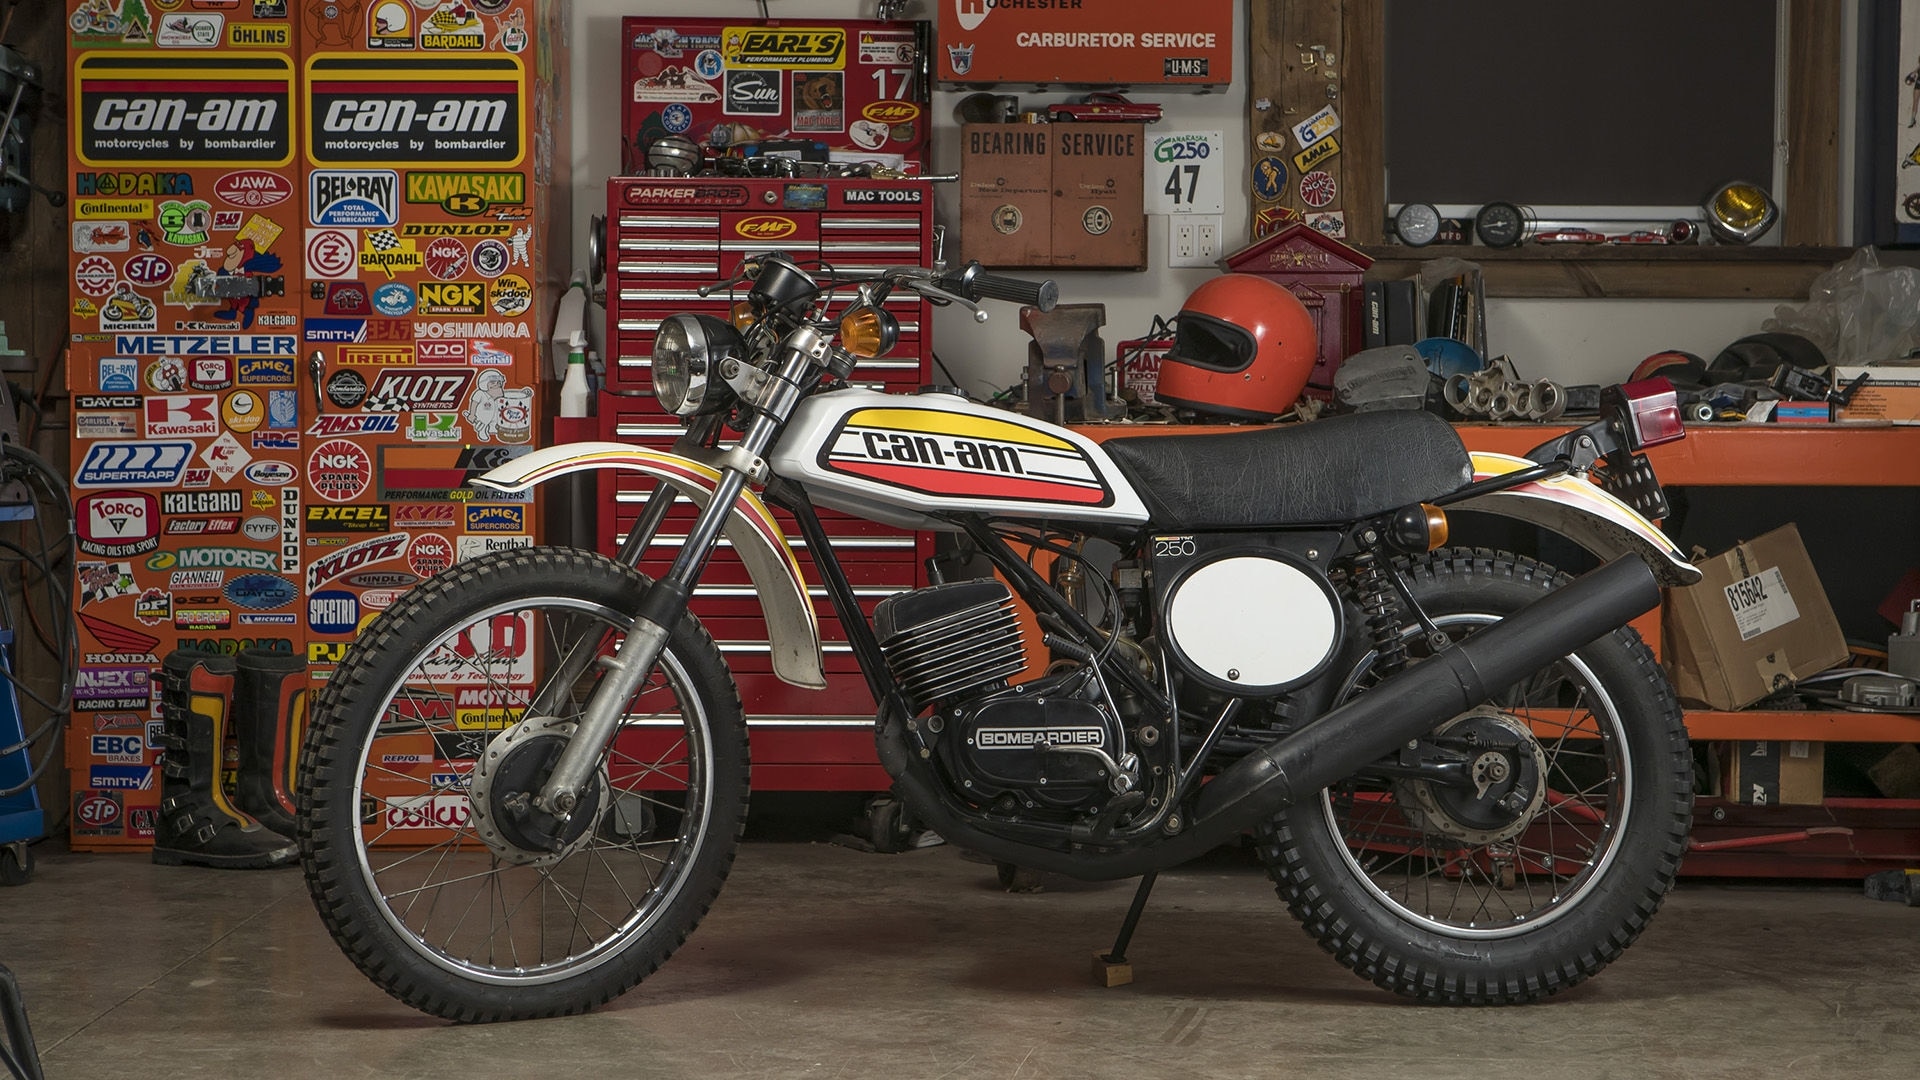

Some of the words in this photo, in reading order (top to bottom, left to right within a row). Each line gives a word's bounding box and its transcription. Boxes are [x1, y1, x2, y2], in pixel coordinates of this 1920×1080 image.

[233, 25, 286, 43] ÖHLINS
[1016, 32, 1135, 47] CARBURETOR
[1140, 32, 1216, 48] SERVICE
[424, 36, 482, 48] BARDAHL
[742, 34, 837, 52] EARL'S
[733, 81, 778, 100] Sun
[872, 69, 912, 100] 17
[93, 99, 278, 131] can-am
[323, 100, 508, 132] can-am
[869, 107, 914, 116] FMF
[94, 138, 169, 151] motorcycles
[180, 138, 194, 151] by
[205, 138, 276, 149] bombardier
[325, 139, 399, 151] motorcycles
[410, 139, 424, 151] by
[435, 139, 506, 150] bombardier
[971, 132, 1045, 154] BEARING
[1062, 133, 1135, 156] SERVICE
[1302, 142, 1333, 166] AMAL
[76, 172, 193, 195] HODAKA
[230, 177, 277, 189] JAWA
[408, 176, 521, 200] KAWASAKI
[1165, 165, 1200, 204] 47
[1305, 180, 1325, 193] NGK
[846, 192, 874, 201] MAC
[878, 192, 920, 201] TOOLS
[80, 203, 142, 215] Continental
[403, 225, 510, 235] DUNLOP
[742, 222, 791, 231] FMF
[167, 232, 205, 244] KAWASAKI
[361, 253, 421, 265] BARDAHL
[432, 247, 460, 258] NGK
[130, 257, 166, 279] STP
[422, 285, 481, 306] NGK
[198, 322, 240, 330] Kawasaki
[414, 322, 530, 338] YOSHIMURA
[117, 337, 296, 354] METZELER
[420, 344, 464, 354] VDO
[340, 346, 412, 364] PIRELLI
[198, 362, 224, 371] TORCO
[240, 362, 292, 376] CAMEL
[380, 376, 465, 401] KLOTZ
[82, 398, 136, 406] DAYCO
[148, 422, 215, 435] Kawasaki
[311, 415, 399, 432] AMSOIL
[253, 433, 298, 447] HRC
[407, 428, 460, 438] Kawasaki
[863, 432, 1026, 474] can-am
[319, 455, 359, 469] NGK
[84, 471, 175, 481] SUPERTRAPP
[385, 491, 447, 499] PERFORMANCE
[450, 491, 473, 499] GOLD
[476, 491, 488, 499] OIL
[492, 491, 525, 499] FILTERS
[92, 501, 143, 520] TORCO
[307, 507, 389, 520] EXCEL
[396, 506, 454, 519] KYB
[469, 508, 520, 523] CAMEL
[169, 519, 206, 532] Factory
[207, 520, 232, 530] Effex
[284, 490, 298, 570] DUNLOP
[81, 540, 105, 555] RACING
[107, 545, 121, 555] OILS
[122, 544, 136, 555] FOR
[136, 537, 158, 552] SPORT
[415, 545, 444, 556] NGK
[486, 538, 529, 551] Renthal
[1156, 540, 1196, 556] 250
[180, 550, 278, 569] MOTOREX
[315, 539, 406, 586] KLOTZ
[172, 571, 222, 584] GIANNELLI
[1727, 576, 1768, 612] 815642
[139, 600, 168, 610] DP
[310, 599, 355, 624] SPECTRO
[177, 613, 197, 622] PRO
[198, 613, 228, 622] CIRCUIT
[86, 654, 159, 663] HONDA
[452, 672, 464, 681] by
[468, 672, 524, 681] Technology
[78, 700, 114, 709] RACING
[117, 699, 146, 708] TEAM
[458, 690, 530, 705] MOTUL
[92, 736, 142, 754] EBC
[981, 732, 1099, 744] BOMBARDIER
[92, 778, 140, 786] SMITH
[83, 800, 115, 820] STP
